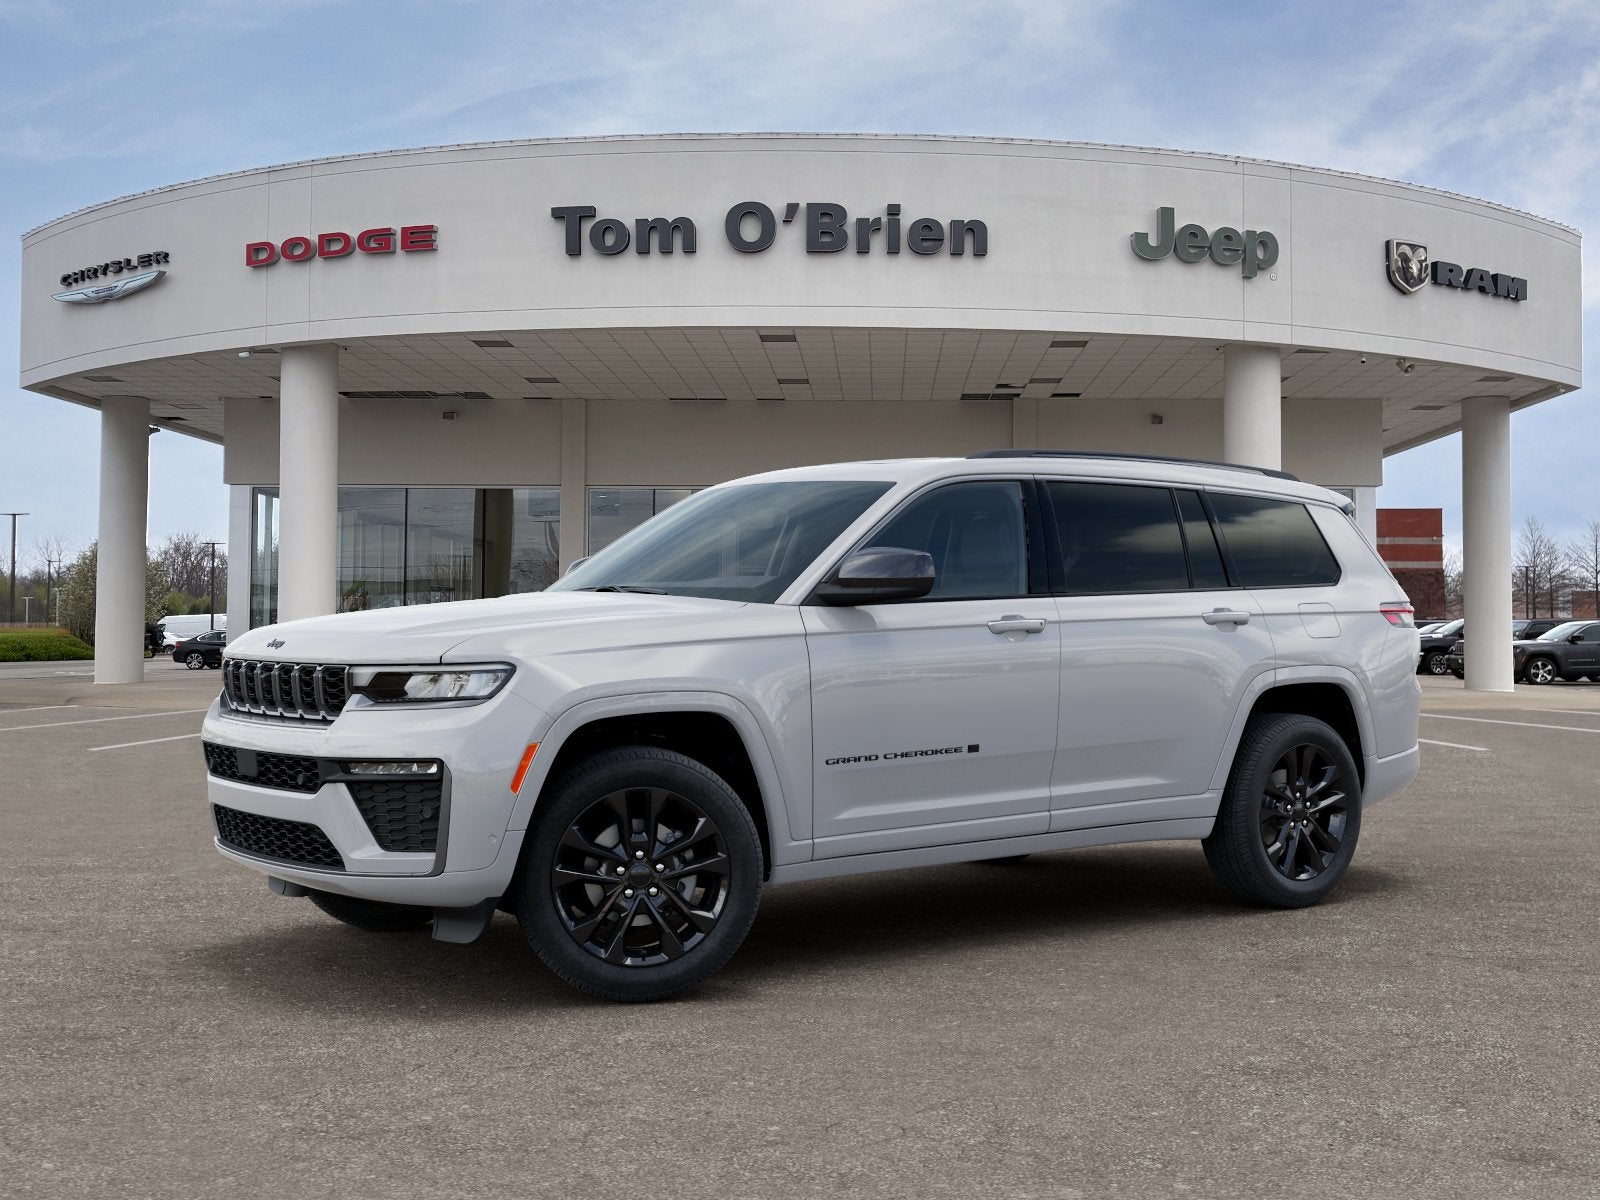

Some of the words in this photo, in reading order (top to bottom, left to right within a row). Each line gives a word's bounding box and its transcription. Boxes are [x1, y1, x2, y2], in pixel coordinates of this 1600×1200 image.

[245, 225, 438, 268] DODGE
[551, 206, 697, 256] Tom
[725, 201, 989, 257] O'Brien
[1131, 206, 1280, 279] Jeep
[59, 250, 170, 287] CHRYSLER
[1430, 260, 1528, 302] RAM
[266, 638, 286, 650] Jeep
[825, 754, 879, 766] GRAND
[883, 746, 964, 760] CHEROKEE
